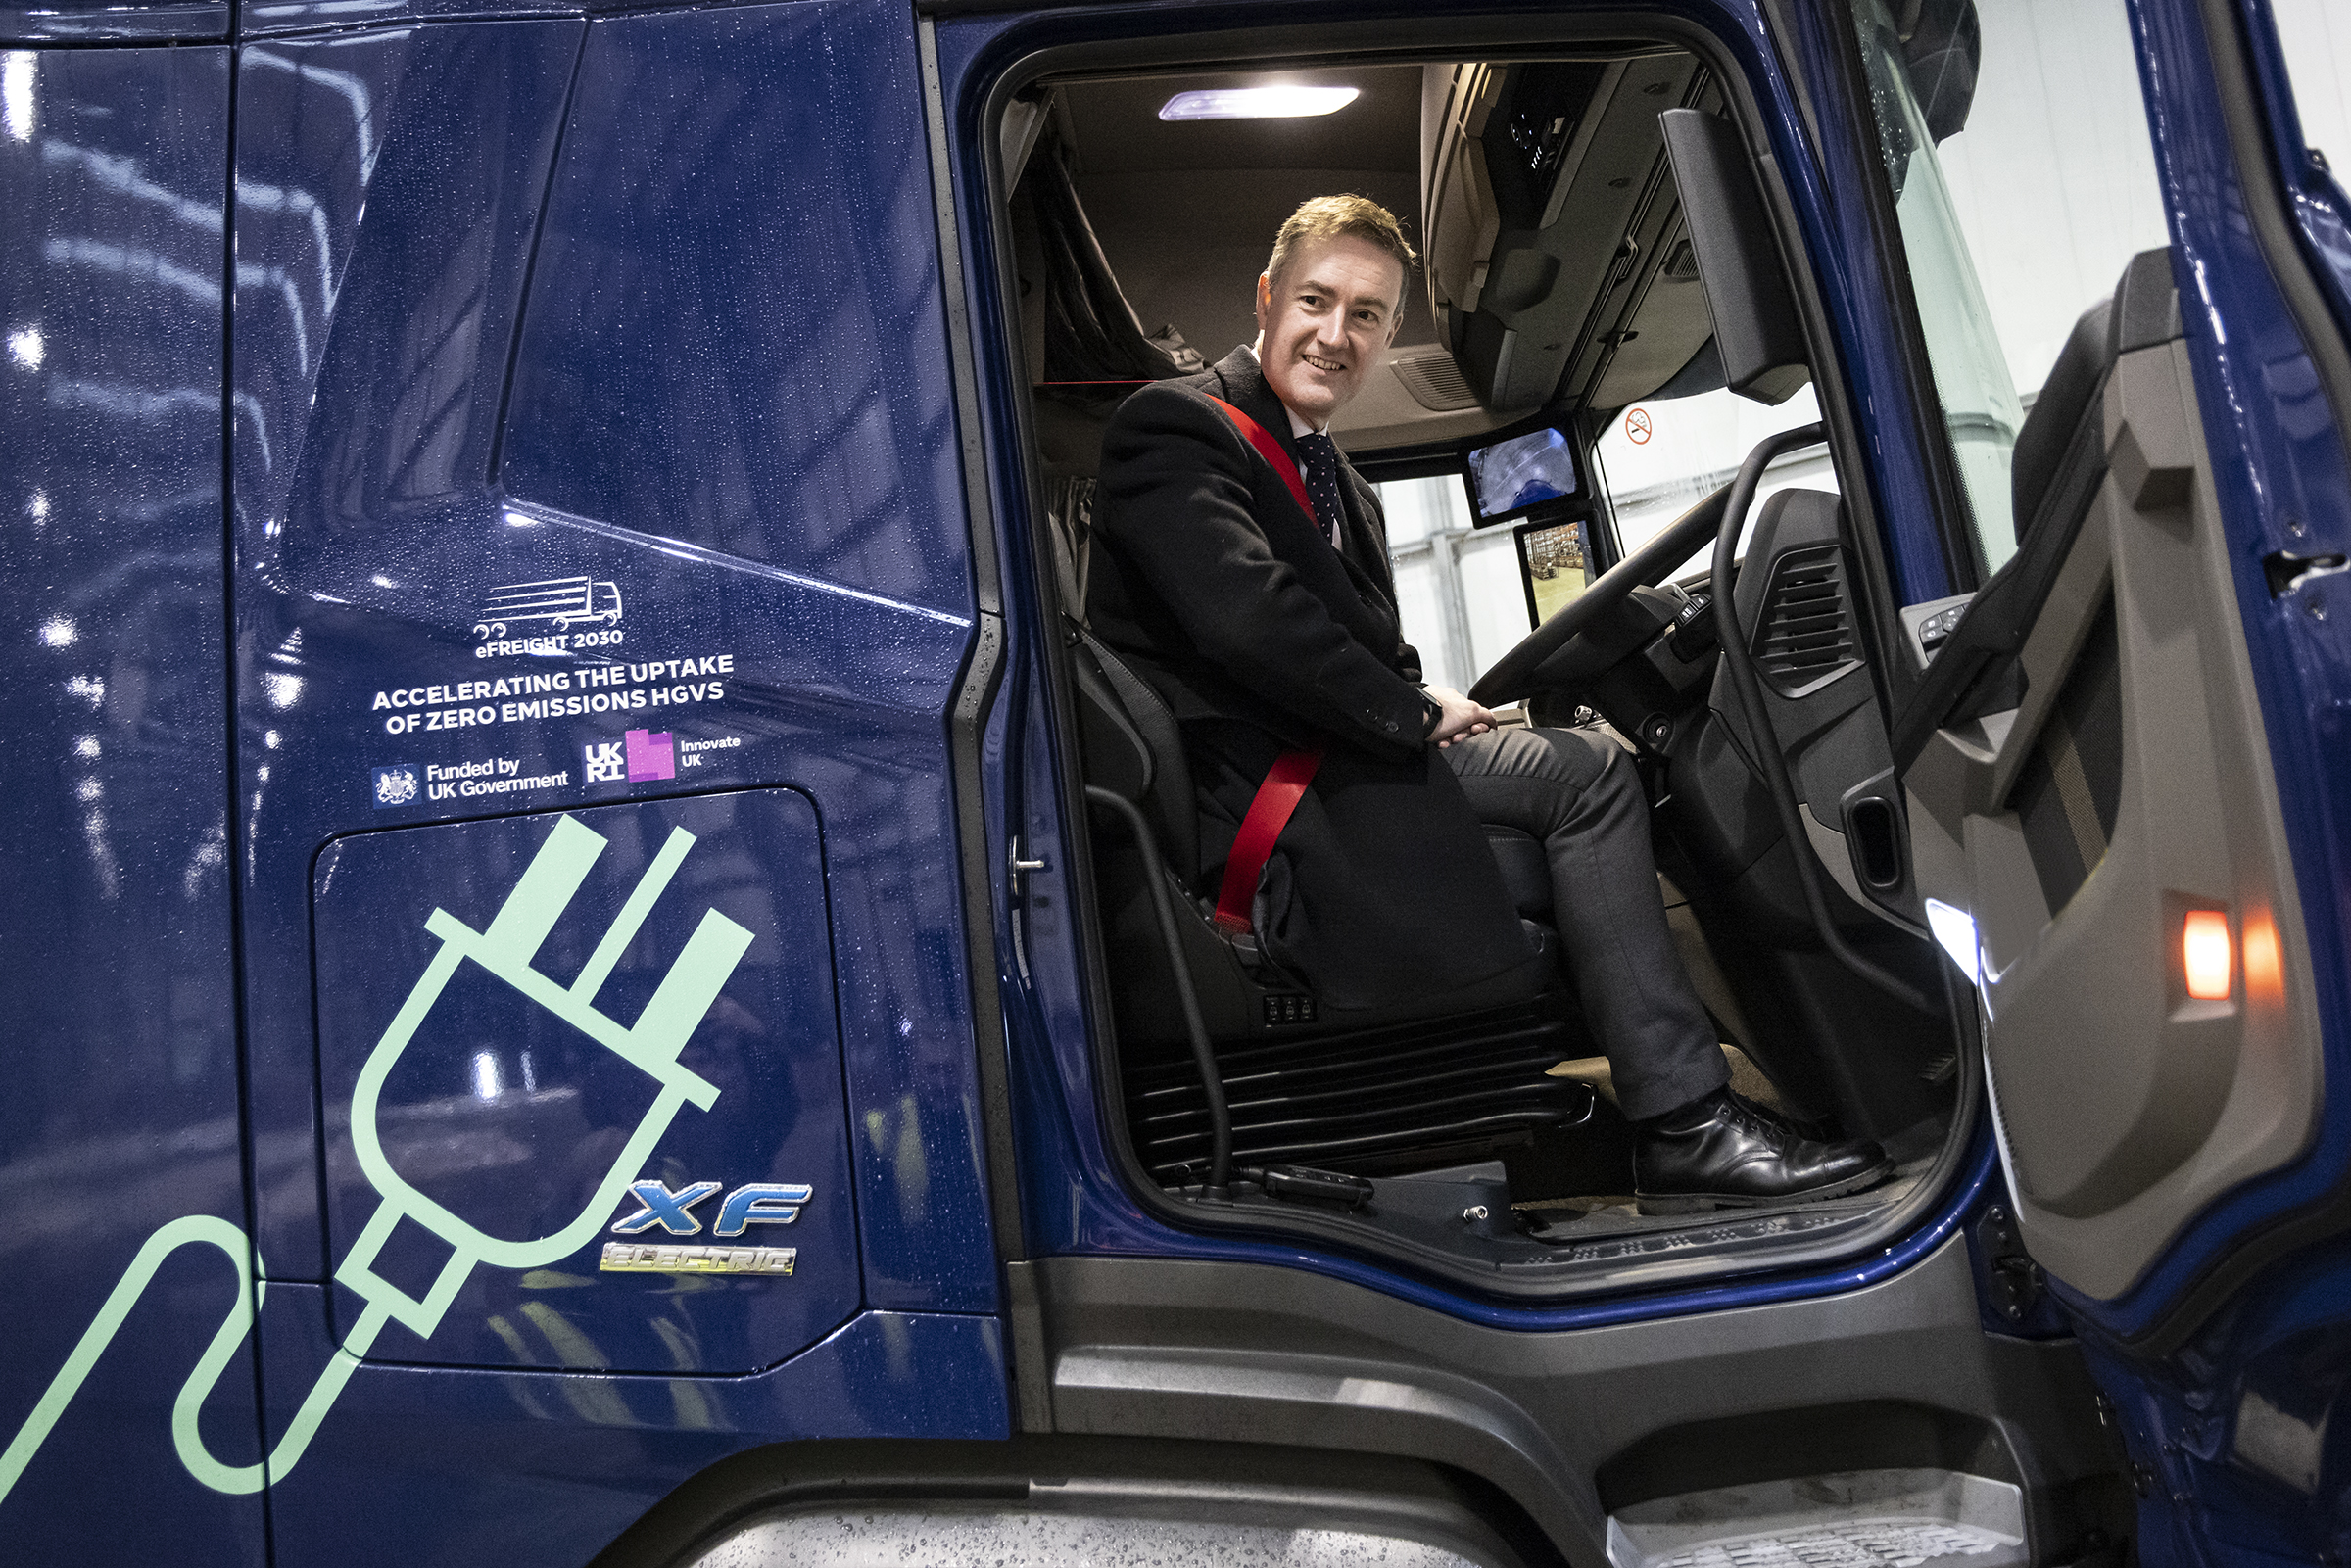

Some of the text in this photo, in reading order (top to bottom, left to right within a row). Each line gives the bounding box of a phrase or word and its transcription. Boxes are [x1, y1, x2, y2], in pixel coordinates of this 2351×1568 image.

[476, 630, 623, 658] eFREIGHT 2030
[372, 654, 734, 710] ACCELERATING THE UPTAKE
[386, 682, 724, 734] OF ZERO EMISSIONS HGVS
[585, 742, 623, 764] UK
[681, 736, 741, 752] Innovate
[427, 758, 519, 781] Funded by
[587, 762, 625, 782] RI
[682, 754, 701, 767] UK
[428, 771, 568, 800] UK Government
[610, 1179, 813, 1236] XF
[607, 1245, 792, 1271] ELECTRIC
